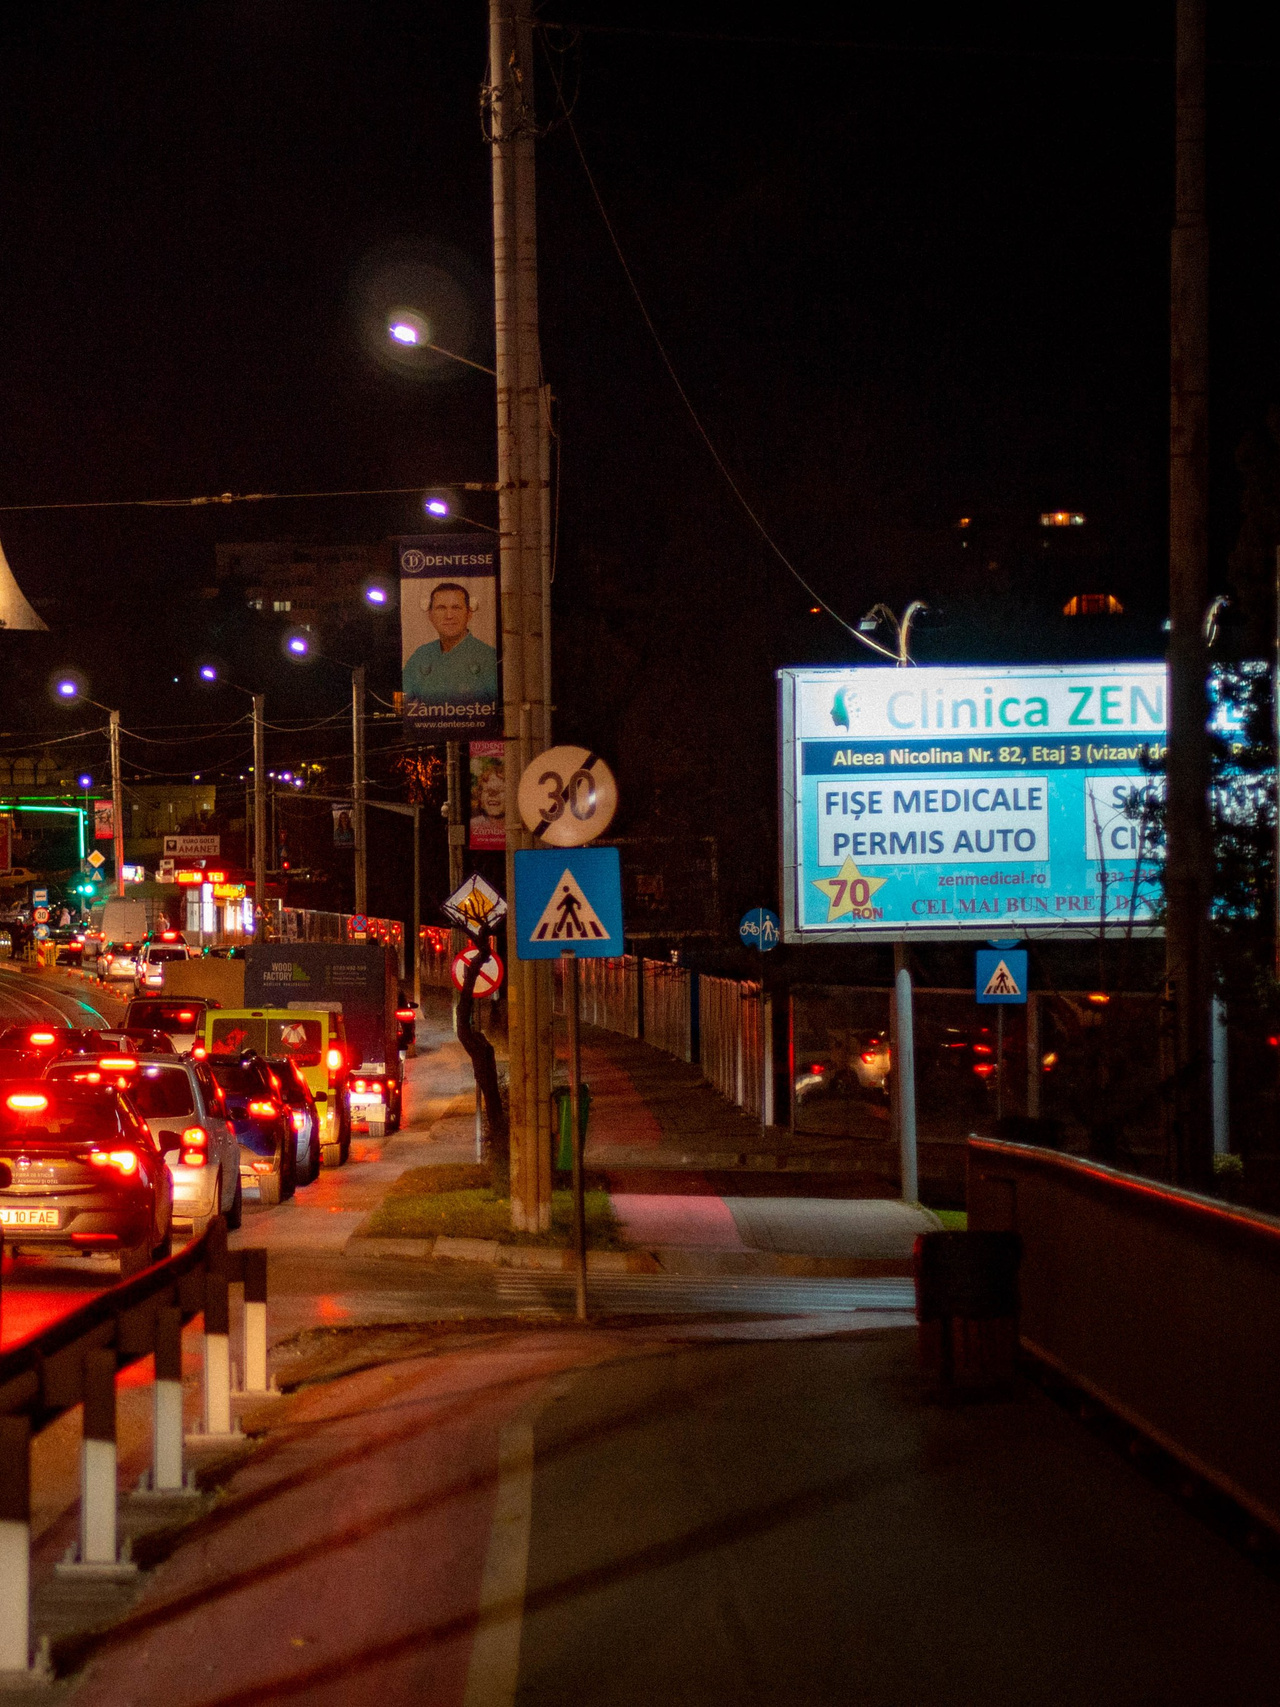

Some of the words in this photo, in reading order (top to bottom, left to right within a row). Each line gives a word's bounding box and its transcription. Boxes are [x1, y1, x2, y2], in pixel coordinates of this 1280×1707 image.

[426, 554, 493, 566] DENTESSE
[886, 686, 1050, 729] Clinica
[1068, 685, 1164, 726] ZEN
[414, 720, 486, 729] www.dentesse.ro
[833, 749, 885, 767] Aleea
[890, 747, 963, 764] Nicolina
[969, 746, 995, 762] Nr.
[999, 746, 1026, 766] 82,
[1032, 744, 1066, 766] Etaj
[1071, 744, 1082, 761] 3
[537, 768, 597, 823] 30
[894, 787, 1043, 815] MEDICALE
[179, 845, 218, 853] AMANET
[833, 830, 944, 858] PERMIS
[954, 828, 1037, 855] AUTO
[938, 872, 1047, 888] zenmedical.ro
[829, 878, 870, 908] 70
[911, 899, 954, 915] CEL
[958, 898, 999, 914] MAI
[1006, 896, 1050, 912] BUN
[37, 911, 46, 919] 30
[852, 908, 883, 921] RON
[272, 963, 292, 971] WOOD
[263, 972, 292, 981] FACTORY
[15, 1211, 26, 1223] 10
[29, 1211, 55, 1223] FAE
